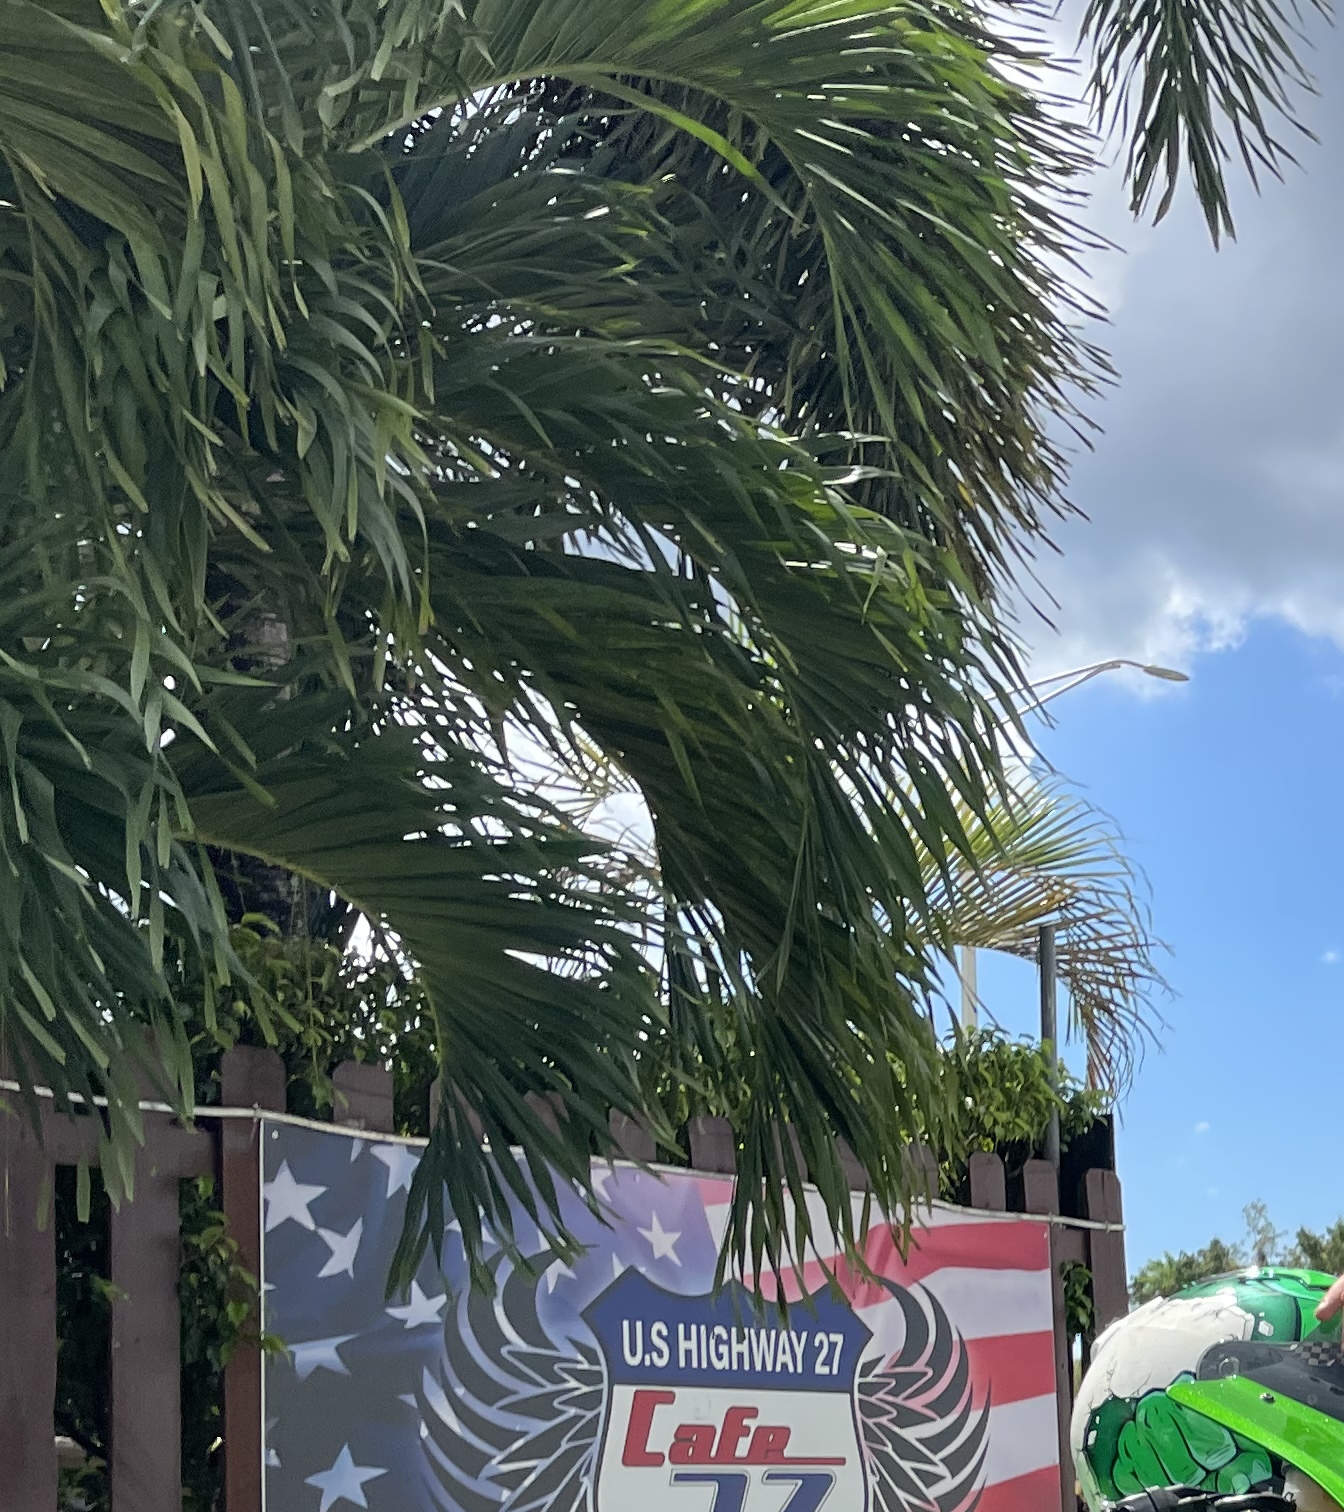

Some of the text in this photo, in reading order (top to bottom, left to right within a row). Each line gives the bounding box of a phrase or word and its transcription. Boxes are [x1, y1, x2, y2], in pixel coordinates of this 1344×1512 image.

[621, 1319, 845, 1376] U.S HIGHWAY 27
[621, 1389, 847, 1467] Cafe
